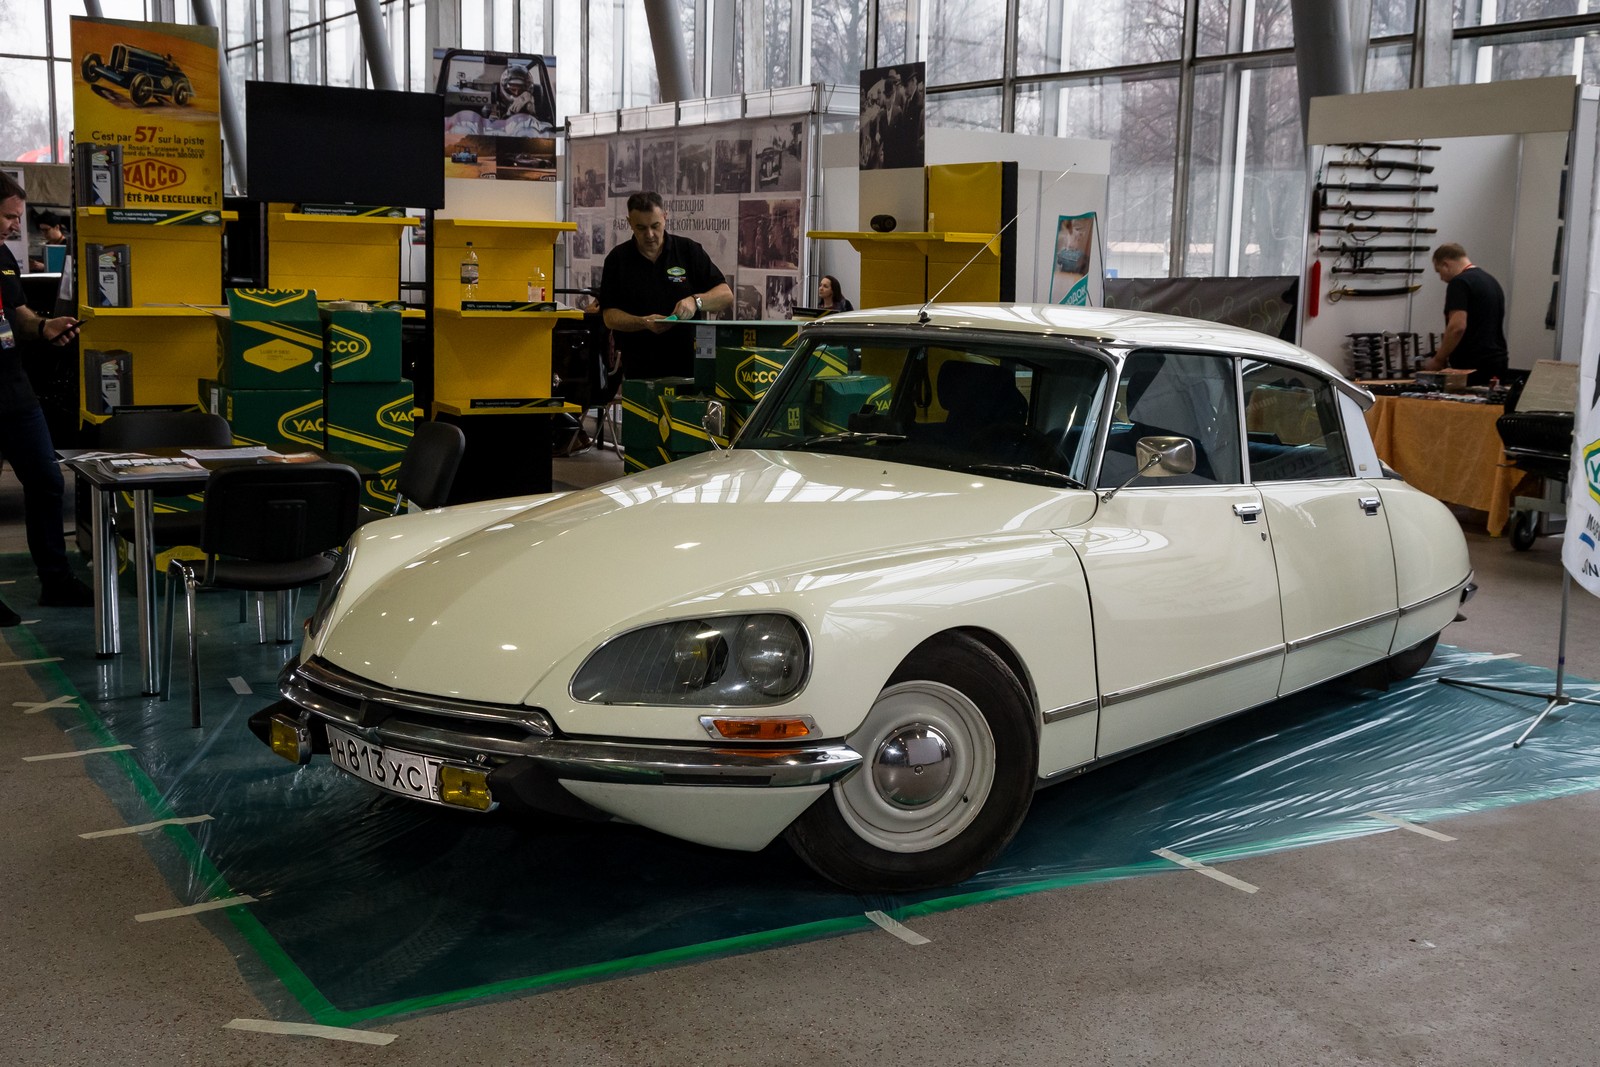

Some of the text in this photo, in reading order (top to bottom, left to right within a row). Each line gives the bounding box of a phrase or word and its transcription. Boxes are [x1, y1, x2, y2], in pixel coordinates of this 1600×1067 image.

[459, 95, 489, 103] YACCO
[117, 133, 132, 144] par
[158, 136, 172, 144] sur
[174, 134, 182, 144] la
[183, 136, 205, 146] piste
[123, 161, 178, 188] YACCO
[144, 193, 160, 203] PAR
[161, 194, 213, 205] EXCELLENCE
[741, 370, 777, 383] YACCO
